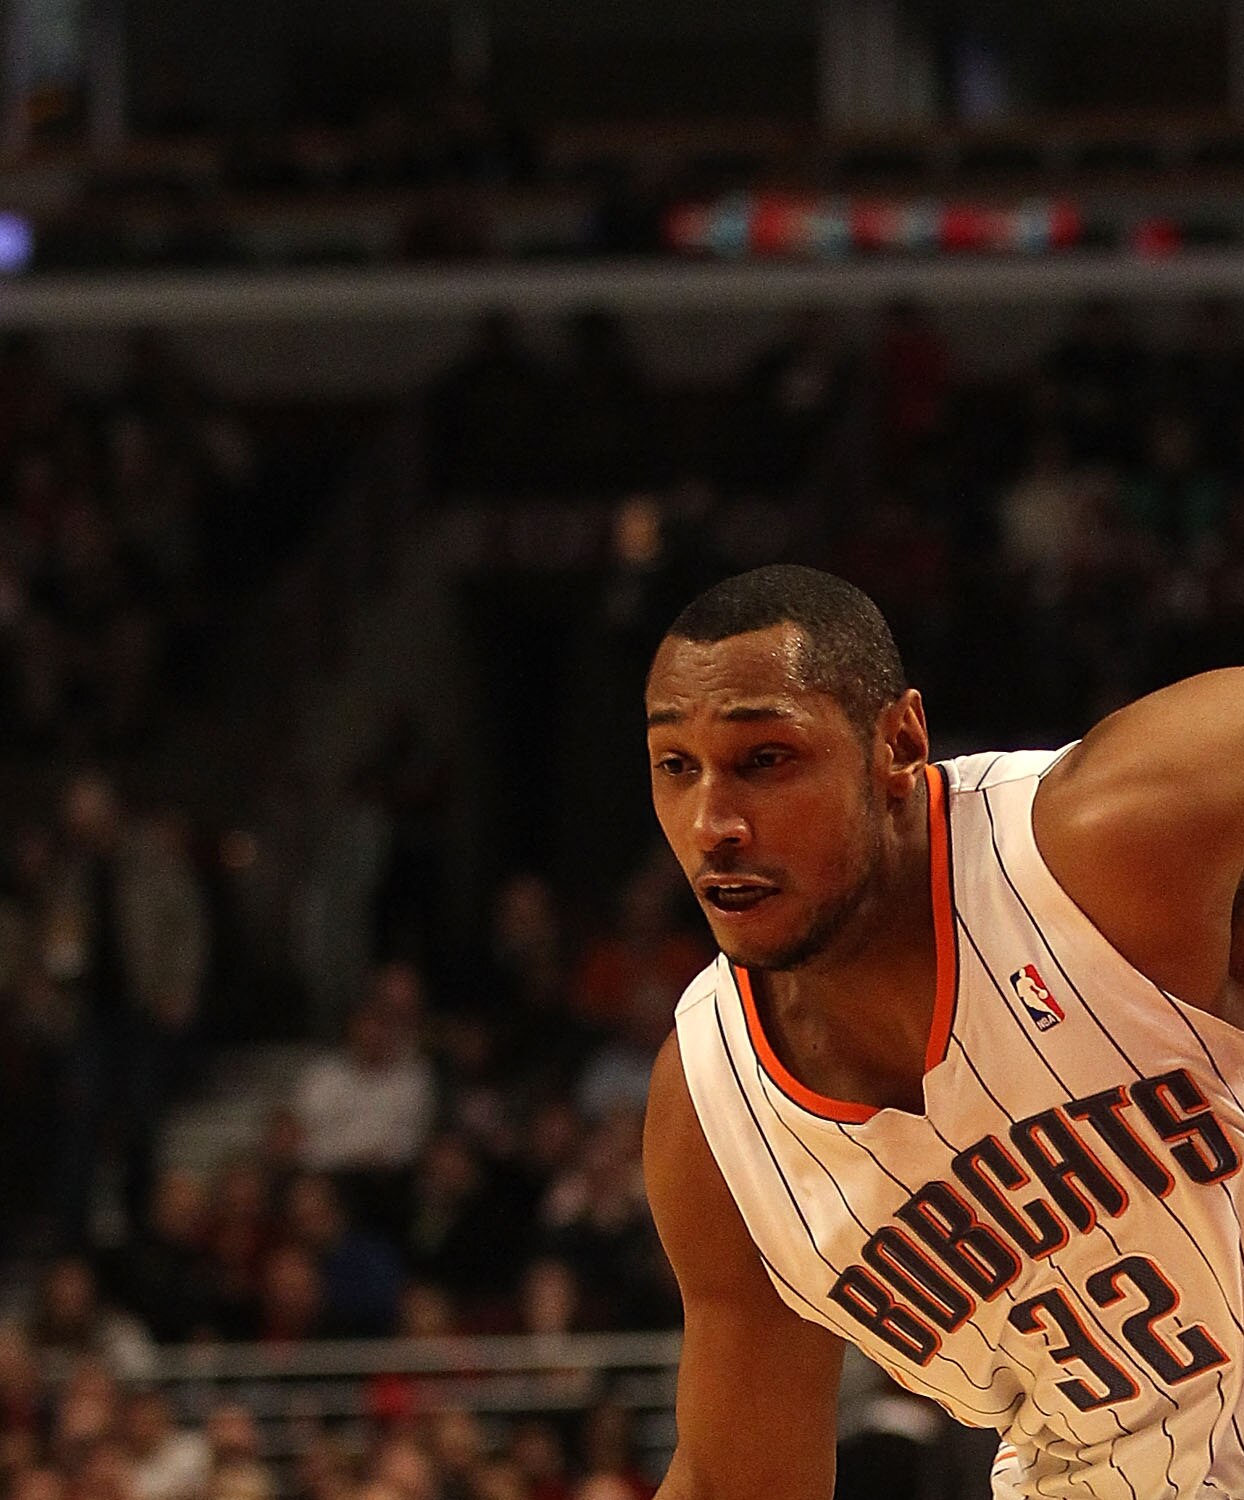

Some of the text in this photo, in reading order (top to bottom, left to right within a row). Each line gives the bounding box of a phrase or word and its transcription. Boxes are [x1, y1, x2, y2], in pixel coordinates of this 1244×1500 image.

[1037, 1014, 1056, 1030] NBA
[828, 1068, 1242, 1367] BOBCATS
[1008, 1254, 1230, 1412] 32
